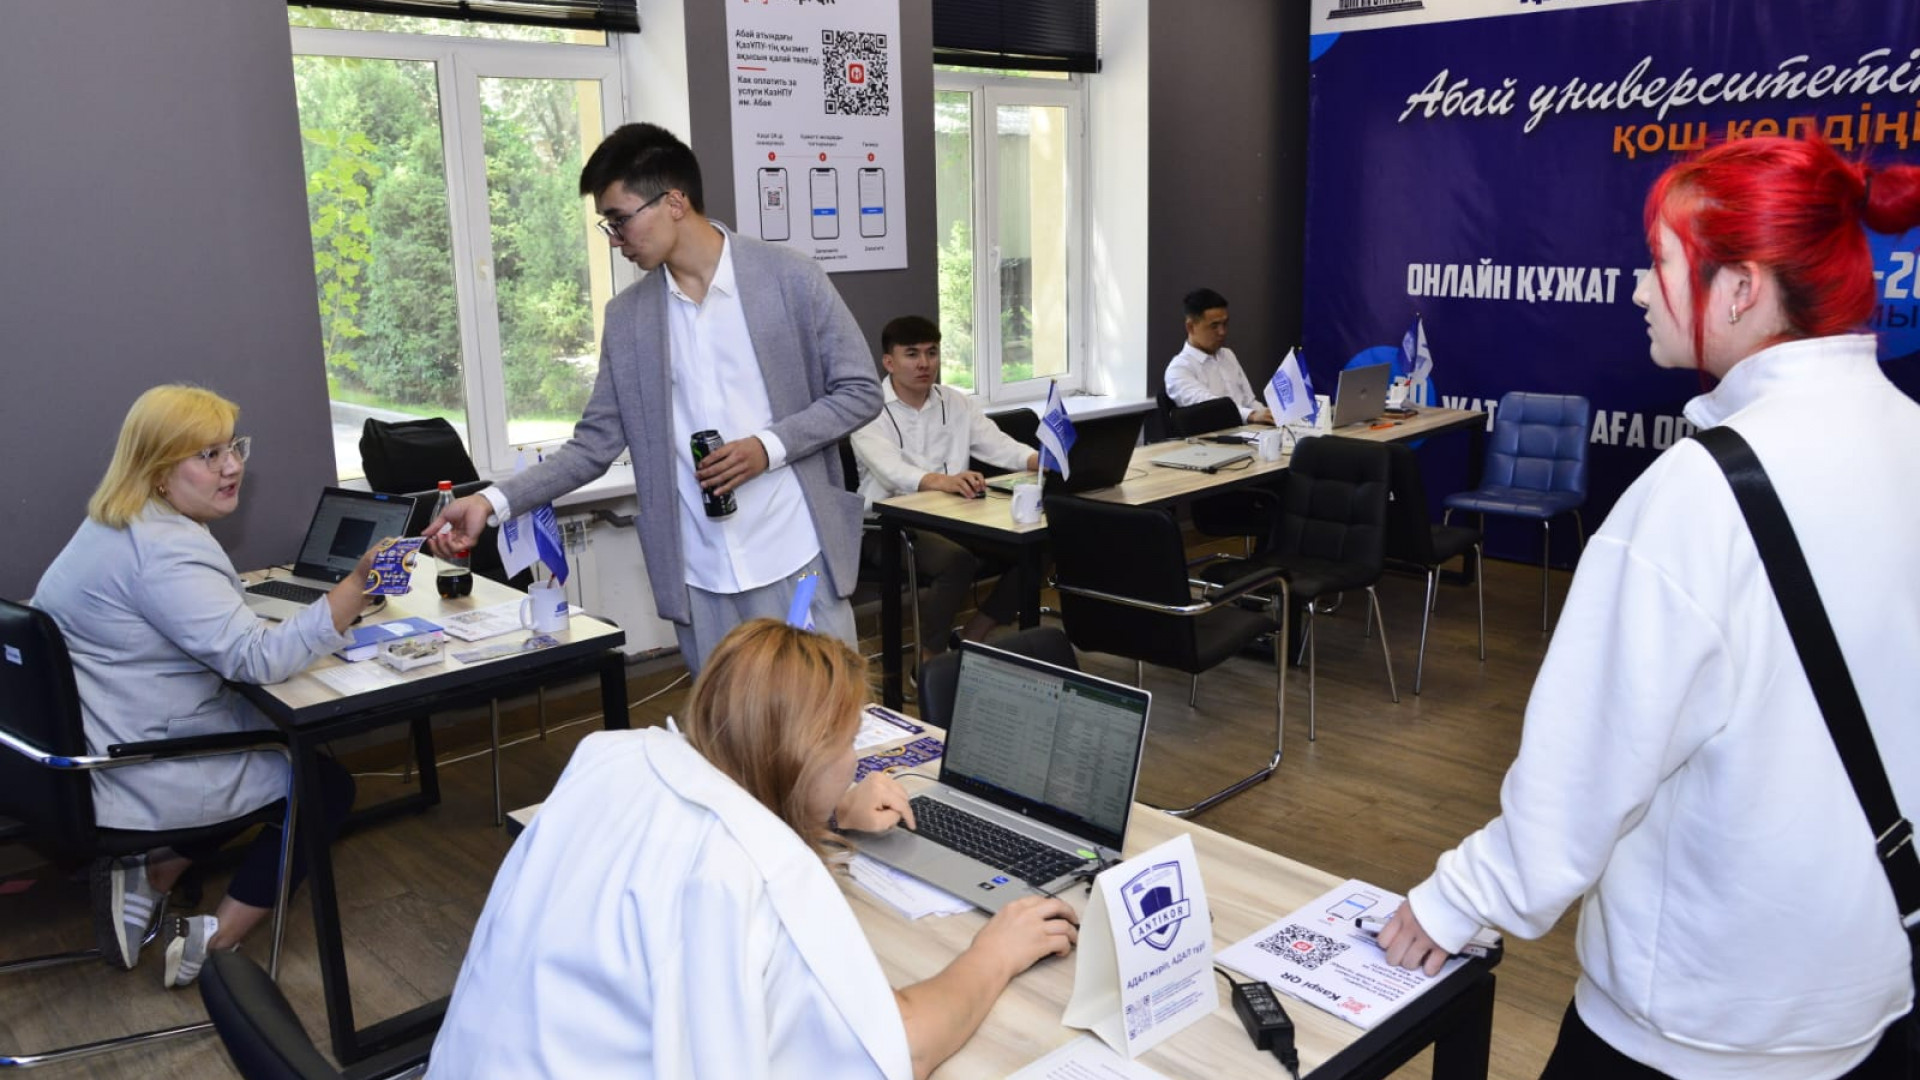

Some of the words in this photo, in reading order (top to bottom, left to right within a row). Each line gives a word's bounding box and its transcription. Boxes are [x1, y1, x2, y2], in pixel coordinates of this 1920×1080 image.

[736, 29, 754, 38] Абай
[1398, 68, 1518, 123] Абай
[1612, 121, 1707, 159] қош
[1407, 258, 1512, 300] ОНЛАЙН
[1516, 265, 1621, 304] ҚҰЖАТ
[1138, 906, 1183, 936] ANTIKOR
[1280, 971, 1302, 983] QR
[1302, 981, 1341, 1001] Kaspi
